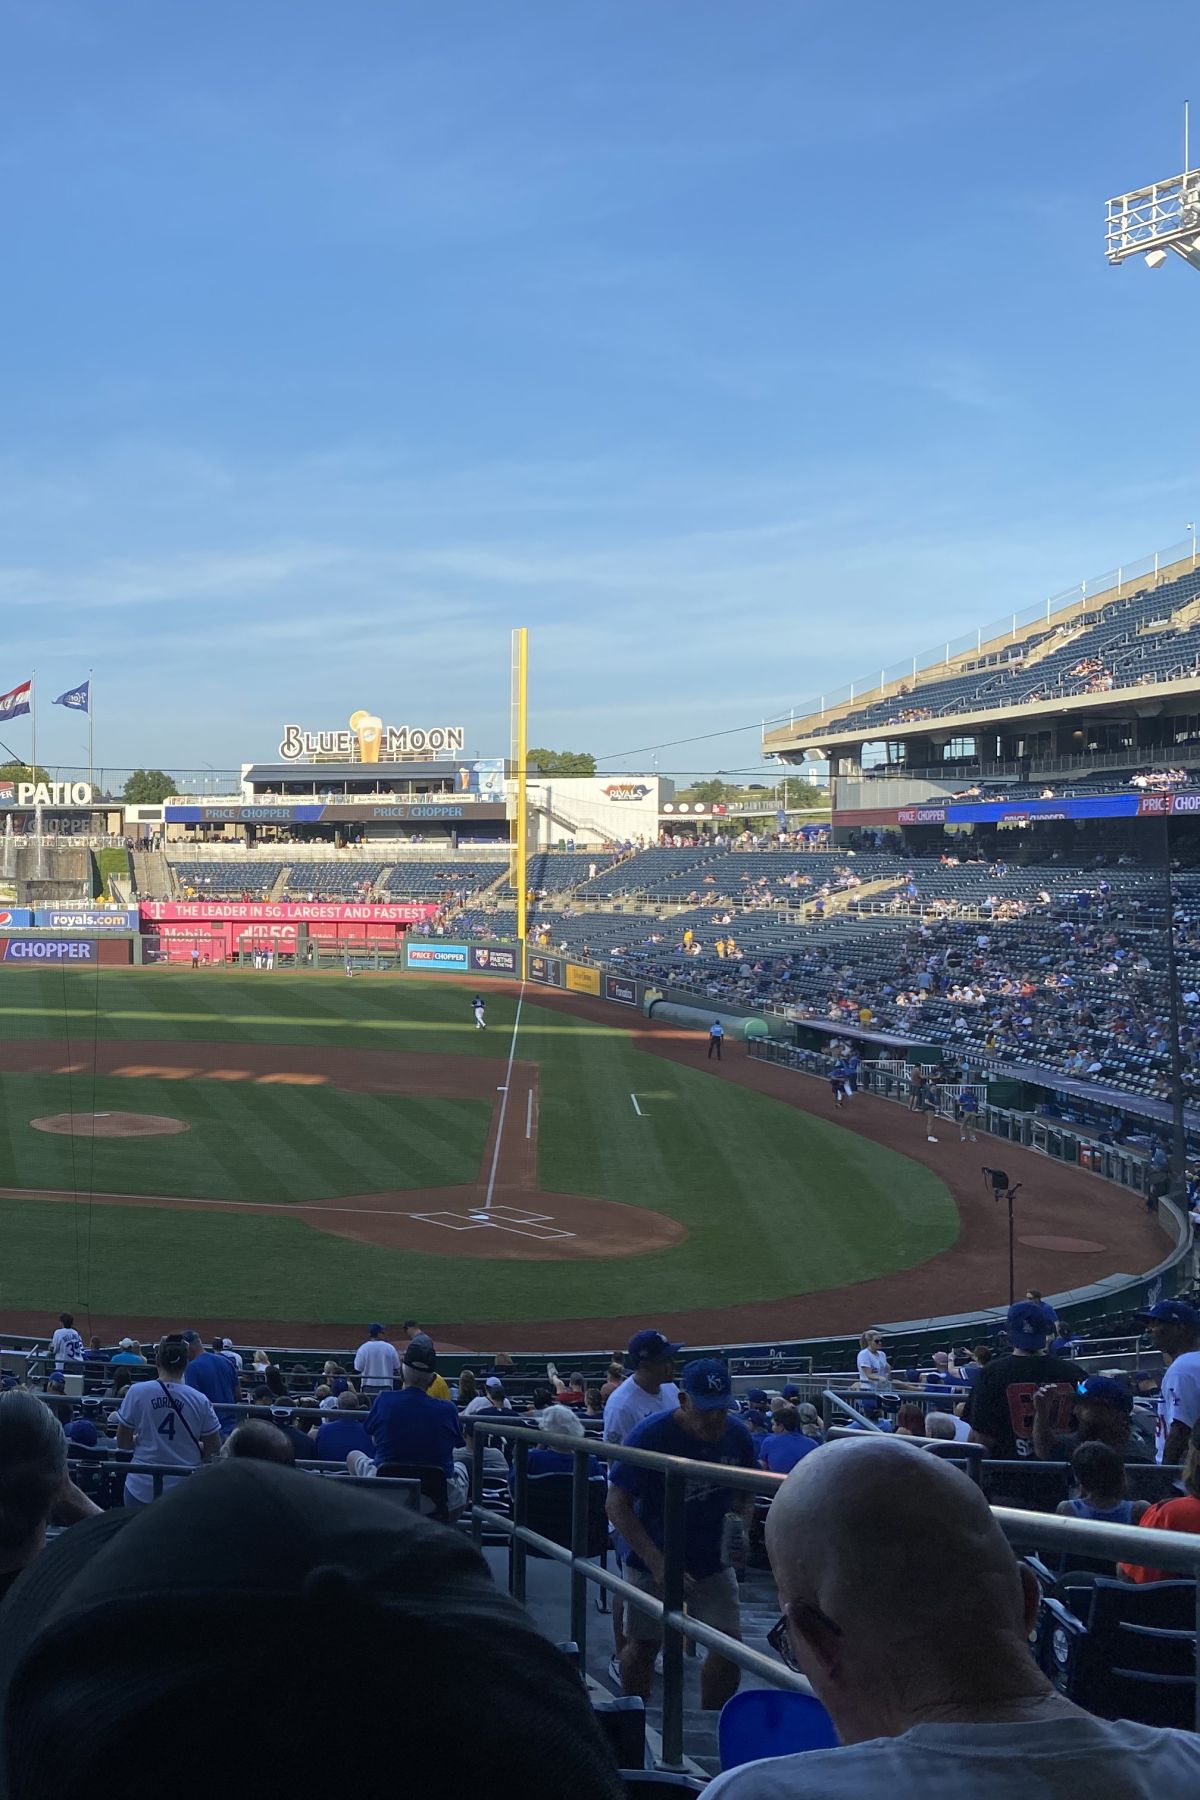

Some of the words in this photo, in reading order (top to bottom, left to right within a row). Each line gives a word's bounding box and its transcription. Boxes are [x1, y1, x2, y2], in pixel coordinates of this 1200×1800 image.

[280, 725, 350, 760] BLUE
[387, 725, 464, 751] MOON
[18, 782, 92, 805] PATIO
[610, 789, 643, 799] RIVALS
[1142, 797, 1169, 811] PRICE
[205, 808, 235, 818] PRICE
[241, 808, 290, 818] CHOPPER
[374, 807, 404, 817] PRICE
[411, 807, 462, 817] CHOPPER
[898, 811, 915, 821] PRICE
[918, 810, 945, 821] CHOPPER
[176, 906, 199, 917] THE
[202, 906, 247, 917] LEADER
[250, 906, 262, 917] IN
[265, 906, 285, 917] 5G.
[288, 906, 341, 918] LARGEST
[344, 907, 371, 918] AND
[374, 908, 427, 919] FASTEST
[53, 914, 125, 927] royals.com
[164, 928, 212, 943] Mobile
[270, 926, 296, 943] 5G
[10, 942, 91, 957] CHOPPER
[412, 952, 431, 960] PRICE
[435, 953, 464, 961] CHOPPER
[158, 1412, 175, 1441] 4
